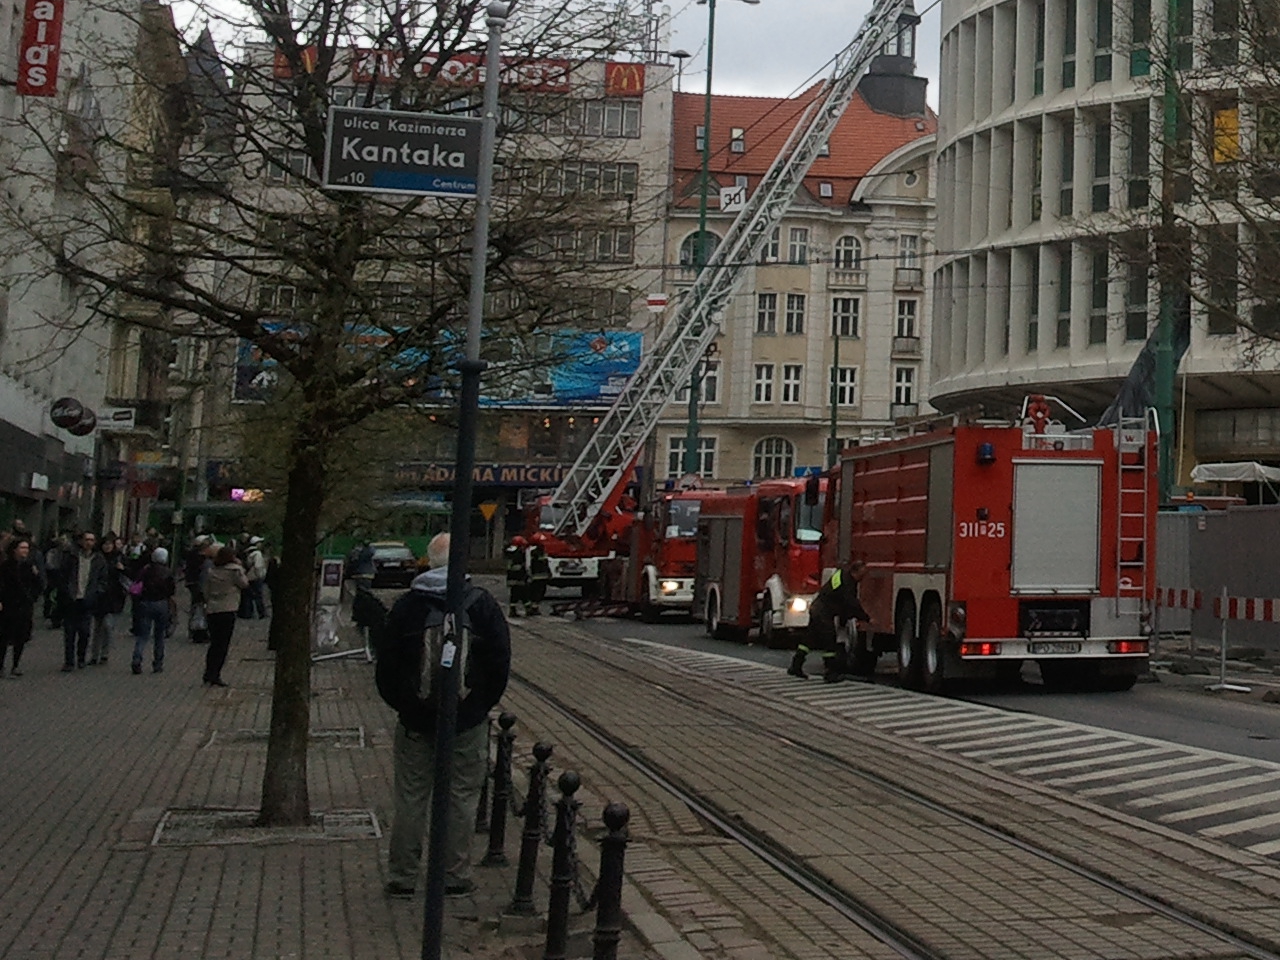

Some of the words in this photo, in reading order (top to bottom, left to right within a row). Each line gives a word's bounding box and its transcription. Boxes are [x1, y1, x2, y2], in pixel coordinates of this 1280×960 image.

[344, 116, 380, 130] ulica
[388, 119, 467, 137] Kazimierza
[342, 137, 465, 168] Kantaka
[350, 172, 366, 184] 10
[432, 178, 476, 190] Centrum
